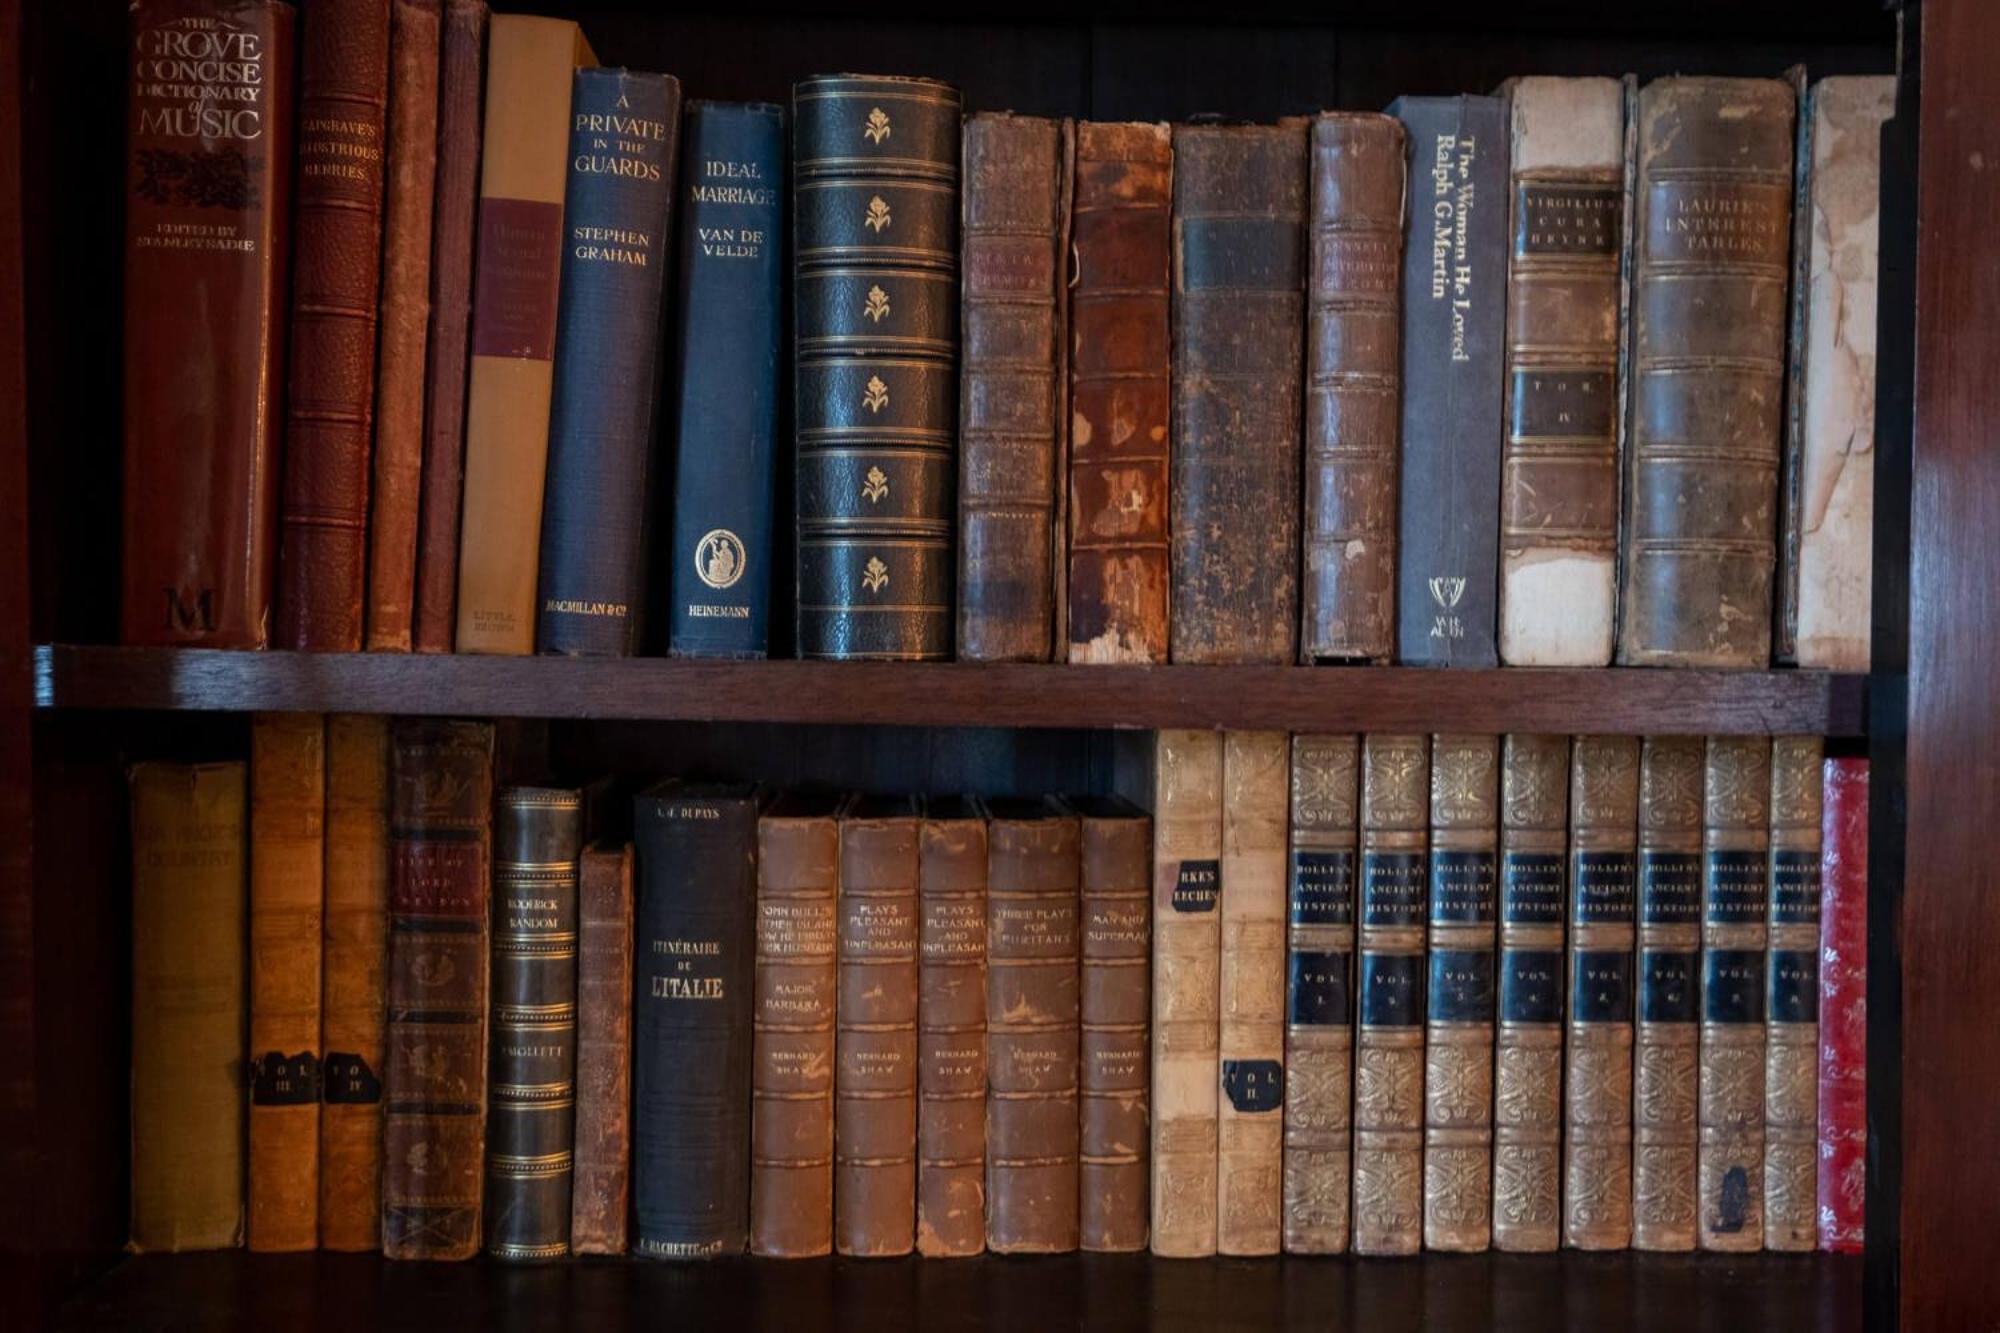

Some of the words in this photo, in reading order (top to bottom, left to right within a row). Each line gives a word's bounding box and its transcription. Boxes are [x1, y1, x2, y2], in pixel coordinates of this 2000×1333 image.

[182, 16, 217, 30] THE
[136, 30, 263, 62] GROVE
[136, 59, 262, 85] CONCISE
[136, 84, 261, 102] DICTIONARY
[616, 95, 630, 110] A
[137, 108, 263, 140] MUSIC
[575, 113, 667, 142] PRIVATE
[593, 137, 609, 150] IN
[617, 141, 649, 154] THE
[1431, 134, 1457, 195] Ralph
[1457, 135, 1476, 181] The
[574, 154, 663, 182] GUARDS
[704, 159, 762, 180] IDEAL
[691, 185, 777, 206] MARRIAGE
[1453, 181, 1476, 261] Woman
[1665, 217, 1777, 234] INTEREST
[573, 226, 651, 249] STEPHEN
[697, 226, 736, 243] VAN
[739, 229, 765, 245] DE
[574, 246, 649, 268] GRAHAM
[702, 242, 760, 259] VELDE
[1431, 227, 1453, 300] Martin
[1453, 263, 1474, 298] He
[1450, 298, 1473, 364] Loved
[546, 598, 606, 617] MACMILLAN
[689, 604, 751, 619] HEINEMANN
[1296, 883, 1351, 893] ANCIENT
[1368, 886, 1421, 896] ANCIENT
[1438, 883, 1491, 893] ANCIENT
[1509, 883, 1561, 894] ANCIENT
[1713, 883, 1765, 894] ANCIENT
[859, 904, 899, 916] PLAYS
[936, 905, 974, 916] PLAYS
[508, 916, 559, 929] RANDOM
[849, 915, 911, 928] PLEASANT
[867, 927, 891, 937] AND
[945, 930, 968, 941] AND
[1001, 934, 1071, 945] PURITANS
[765, 999, 822, 1012] BARBARA
[856, 1052, 901, 1062] BERNARD
[935, 1050, 980, 1060] BERNARD
[859, 1065, 895, 1075] SHAW
[939, 1065, 973, 1076] SHAW
[1100, 1065, 1134, 1076] SHAW
